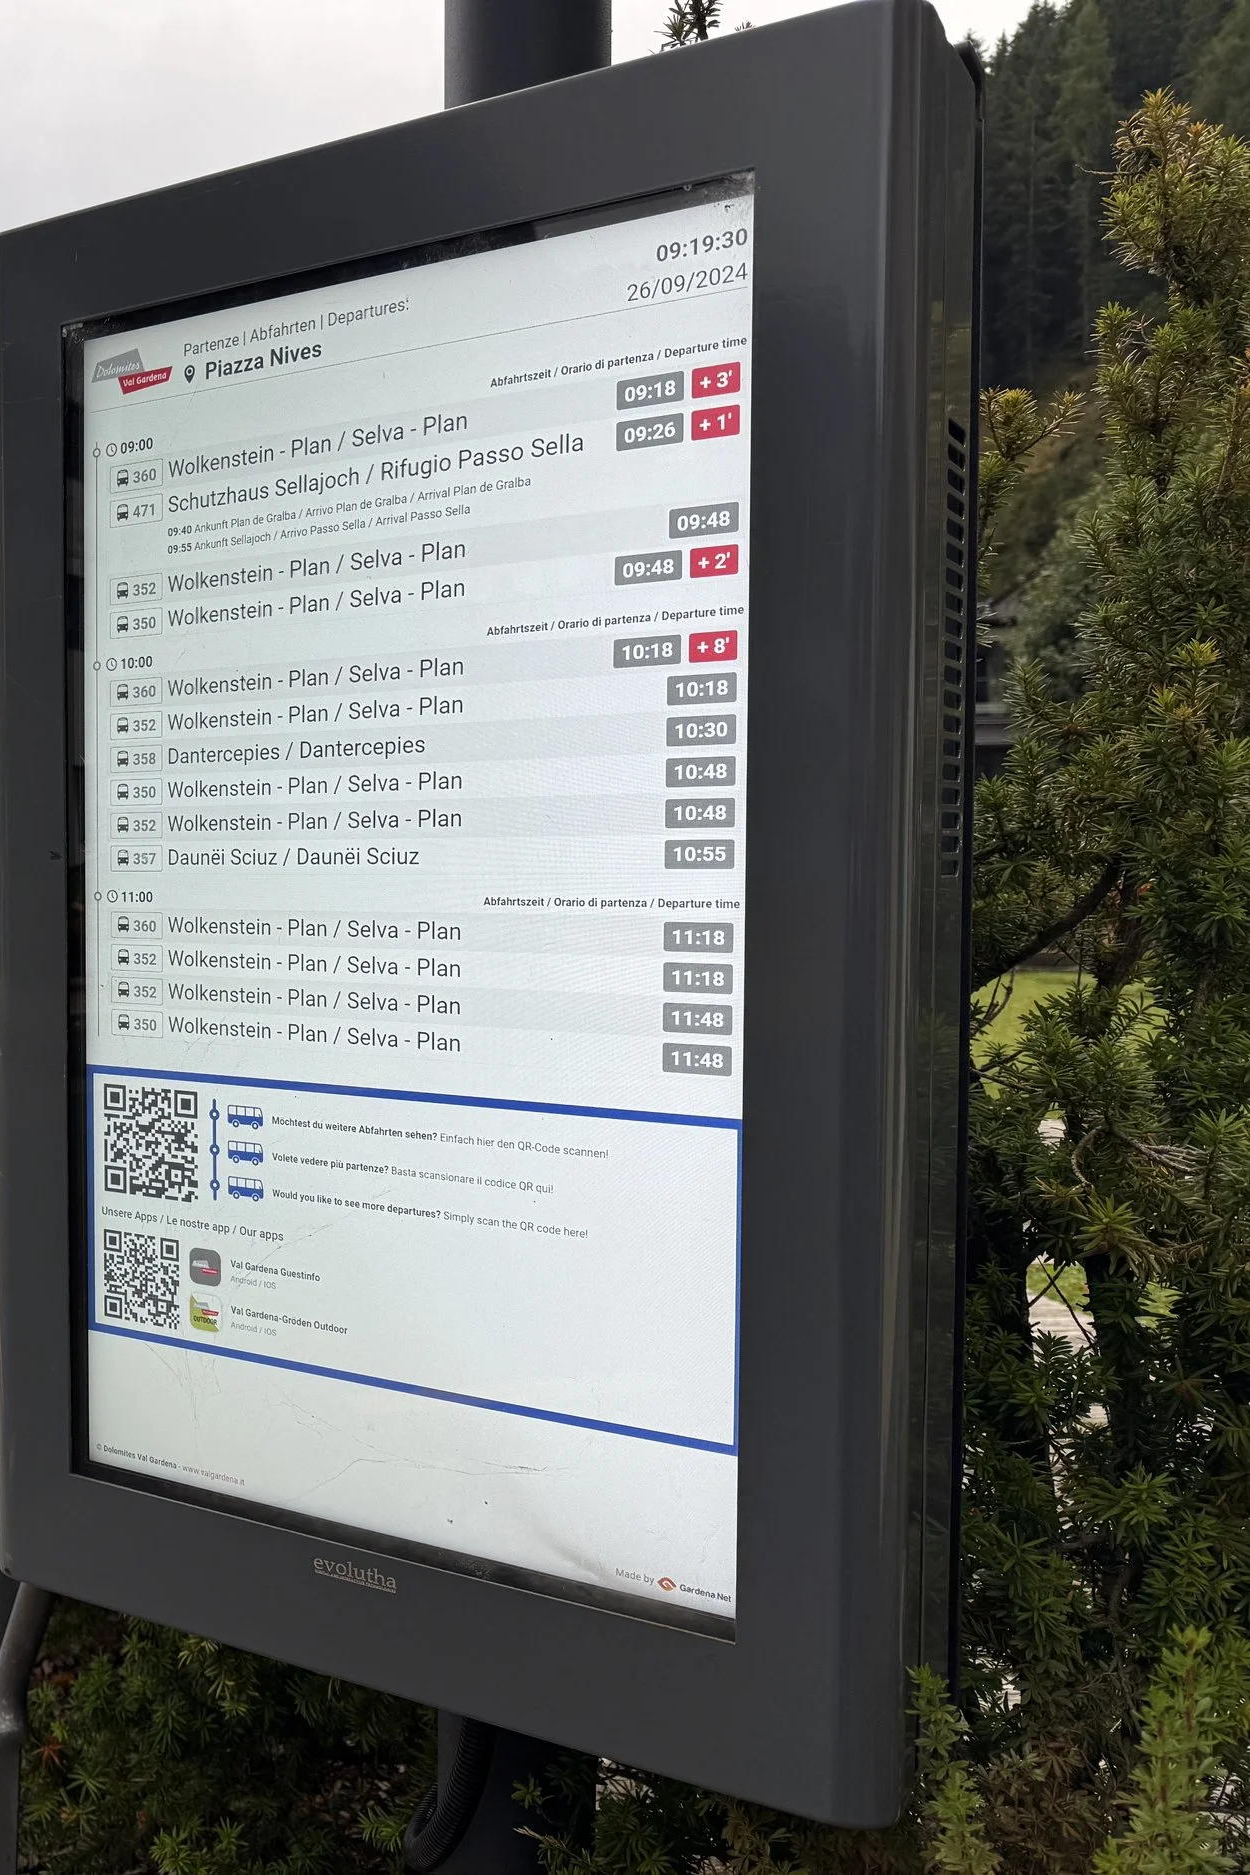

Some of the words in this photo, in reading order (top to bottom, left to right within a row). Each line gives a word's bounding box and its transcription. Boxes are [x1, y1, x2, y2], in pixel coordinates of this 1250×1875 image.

[656, 227, 747, 262] 09:19:30
[627, 262, 748, 301] 26/09/2024
[184, 335, 239, 357] Partenze
[249, 319, 315, 343] Abfahrten
[96, 361, 140, 378] Dolomites
[205, 355, 264, 380] Piazza
[270, 344, 322, 367] Nives
[490, 368, 551, 387] Abfahrtszeit
[561, 362, 592, 375] Orario
[594, 359, 604, 369] di
[607, 353, 654, 370] partenza
[664, 342, 718, 358] Departure
[722, 337, 747, 348] time
[122, 378, 135, 387] Val
[136, 372, 167, 385] Gardena
[624, 379, 676, 402] 09:18
[624, 421, 676, 443] 09:26
[120, 437, 153, 454] 09:00
[168, 445, 273, 478] Wolkenstein
[291, 436, 331, 458] Plan
[352, 423, 403, 447] Selva
[423, 414, 467, 436] Plan
[132, 468, 156, 483] 360
[168, 485, 268, 512] Schutzhaus
[274, 466, 359, 496] Sellajoch
[381, 454, 451, 481] Rifugio
[458, 446, 523, 469] Passo
[531, 432, 583, 457] Sella
[132, 503, 154, 517] 471
[167, 524, 192, 537] 09:40
[194, 519, 228, 533] Ankunft
[230, 517, 250, 528] Plan
[252, 514, 264, 525] de
[266, 510, 296, 523] Gralba
[305, 506, 333, 517] Arrivo
[335, 502, 357, 513] Plan
[359, 499, 372, 509] de
[374, 494, 407, 507] Gralba
[417, 486, 450, 501] Arrival
[453, 484, 476, 496] Plan
[479, 481, 493, 492] de
[495, 476, 531, 490] Gralba
[167, 542, 192, 554] 09:55
[194, 537, 228, 550] Ankunft
[230, 531, 271, 546] Sellajoch
[280, 528, 307, 539] Arrivo
[310, 524, 339, 535] Passo
[341, 518, 365, 530] Sella
[375, 511, 407, 526] Arrival
[410, 510, 442, 522] Passo
[445, 504, 470, 517] Sella
[677, 510, 730, 531] 09:48
[167, 564, 272, 592] Wolkenstein
[290, 558, 329, 578] Plan
[350, 548, 401, 570] Selva
[422, 541, 465, 562] Plan
[622, 558, 674, 578] 09:48
[132, 582, 156, 596] 352
[167, 600, 272, 626] Wolkenstein
[290, 594, 329, 614] Plan
[349, 586, 401, 608] Selva
[421, 579, 464, 600] Plan
[132, 616, 156, 630] 350
[486, 622, 548, 636] Abfahrtszeit
[557, 618, 589, 629] Orario
[592, 616, 601, 626] di
[604, 614, 650, 628] partenza
[661, 608, 716, 621] Departure
[719, 605, 744, 616] time
[120, 655, 152, 669] 10:00
[622, 642, 673, 660] 10:18
[167, 669, 271, 696] Wolkenstein
[289, 668, 328, 687] Plan
[349, 662, 400, 683] Selva
[420, 657, 463, 678] Plan
[132, 684, 156, 698] 360
[675, 721, 728, 738] 10:30
[132, 752, 156, 765] 358
[168, 743, 280, 765] Dantercepies
[300, 736, 425, 759] Dantercepies
[133, 852, 156, 865] 357
[168, 848, 224, 865] Daunëi
[230, 848, 277, 865] Sciuz
[297, 847, 359, 865] Daunëi
[366, 847, 419, 864] Sciuz
[673, 846, 726, 861] 10:55
[121, 891, 153, 903] 11:00
[133, 919, 156, 932] 360
[168, 916, 271, 935] Wolkenstein
[288, 918, 326, 937] Plan
[347, 919, 398, 938] Selva
[418, 921, 460, 940] Plan
[672, 929, 725, 945] 11:18
[133, 1018, 156, 1031] 350
[168, 1016, 271, 1039] Wolkenstein
[288, 1023, 327, 1043] Plan
[347, 1027, 398, 1048] Selva
[417, 1031, 460, 1052] Plan
[671, 1050, 723, 1068] 11:48
[312, 1120, 323, 1129] du
[325, 1122, 356, 1133] weitere
[358, 1125, 402, 1138] Abfahrten
[404, 1130, 437, 1141] sehen?
[440, 1133, 474, 1145] Einfach
[476, 1136, 494, 1147] hier
[497, 1139, 515, 1149] den
[517, 1140, 560, 1154] QR-Code
[563, 1147, 608, 1158] scannen!
[271, 1152, 298, 1163] Volete
[300, 1157, 328, 1167] vedere
[345, 1162, 388, 1174] partenze?
[391, 1166, 416, 1177] Basta
[418, 1171, 474, 1184] scansionare
[476, 1176, 482, 1185] il
[484, 1178, 516, 1189] codice
[519, 1180, 533, 1191] QR
[535, 1184, 553, 1194] qui!
[101, 1205, 132, 1219] Unsere
[134, 1211, 157, 1223] Apps
[166, 1215, 177, 1226] Le
[180, 1218, 209, 1230] nostre
[212, 1223, 230, 1235] app
[239, 1225, 257, 1237] Our
[259, 1230, 283, 1242] apps
[272, 1188, 297, 1200] Would
[299, 1193, 315, 1203] you
[317, 1194, 332, 1205] like
[333, 1197, 342, 1206] to
[344, 1200, 360, 1208] see
[362, 1202, 385, 1212] more
[386, 1203, 441, 1219] departures?
[443, 1211, 474, 1225] Simply
[477, 1217, 499, 1227] scan
[502, 1219, 517, 1229] the
[519, 1220, 534, 1231] QR
[536, 1225, 561, 1235] code
[563, 1226, 588, 1238] here!
[230, 1259, 243, 1269] Val
[244, 1261, 278, 1275] Gardena
[280, 1267, 320, 1281] Guestinfo
[230, 1305, 243, 1315] Val
[313, 1320, 348, 1334] Outdoor
[103, 1444, 135, 1459] Dolomites
[137, 1453, 147, 1462] Val
[149, 1456, 177, 1469] Gardena
[313, 1557, 397, 1589] evolutha
[615, 1567, 641, 1581] Made
[643, 1573, 655, 1585] by
